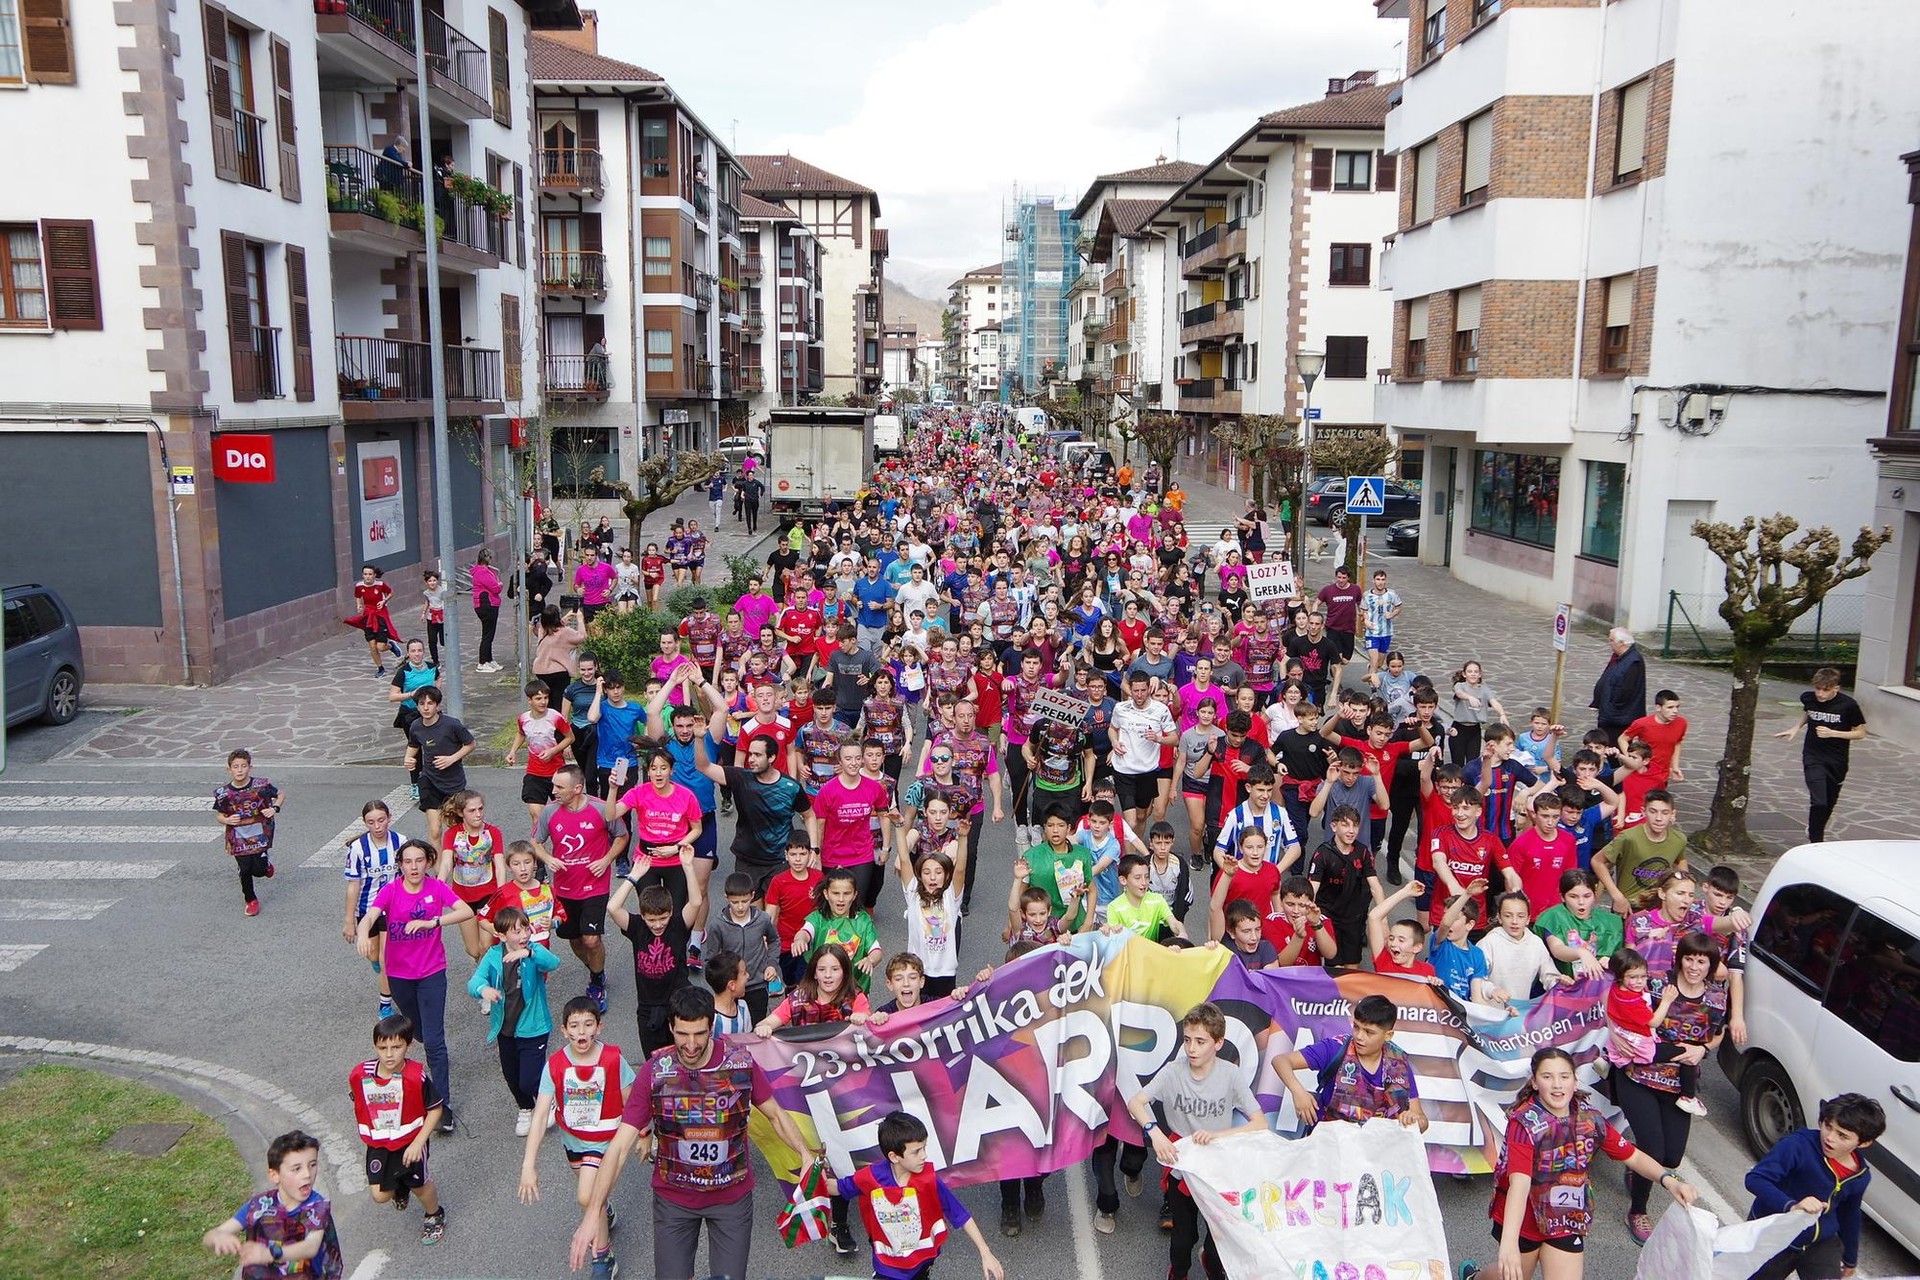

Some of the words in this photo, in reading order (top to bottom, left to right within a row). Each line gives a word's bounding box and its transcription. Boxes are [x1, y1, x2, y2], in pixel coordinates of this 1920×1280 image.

[226, 449, 266, 468] Dia
[1251, 565, 1288, 579] LOZY'S
[1255, 583, 1292, 596] GREBAN
[1032, 704, 1082, 727] GREBAN
[1291, 998, 1352, 1017] Irundik
[792, 988, 1044, 1088] 23.korrika
[690, 1143, 719, 1162] 243
